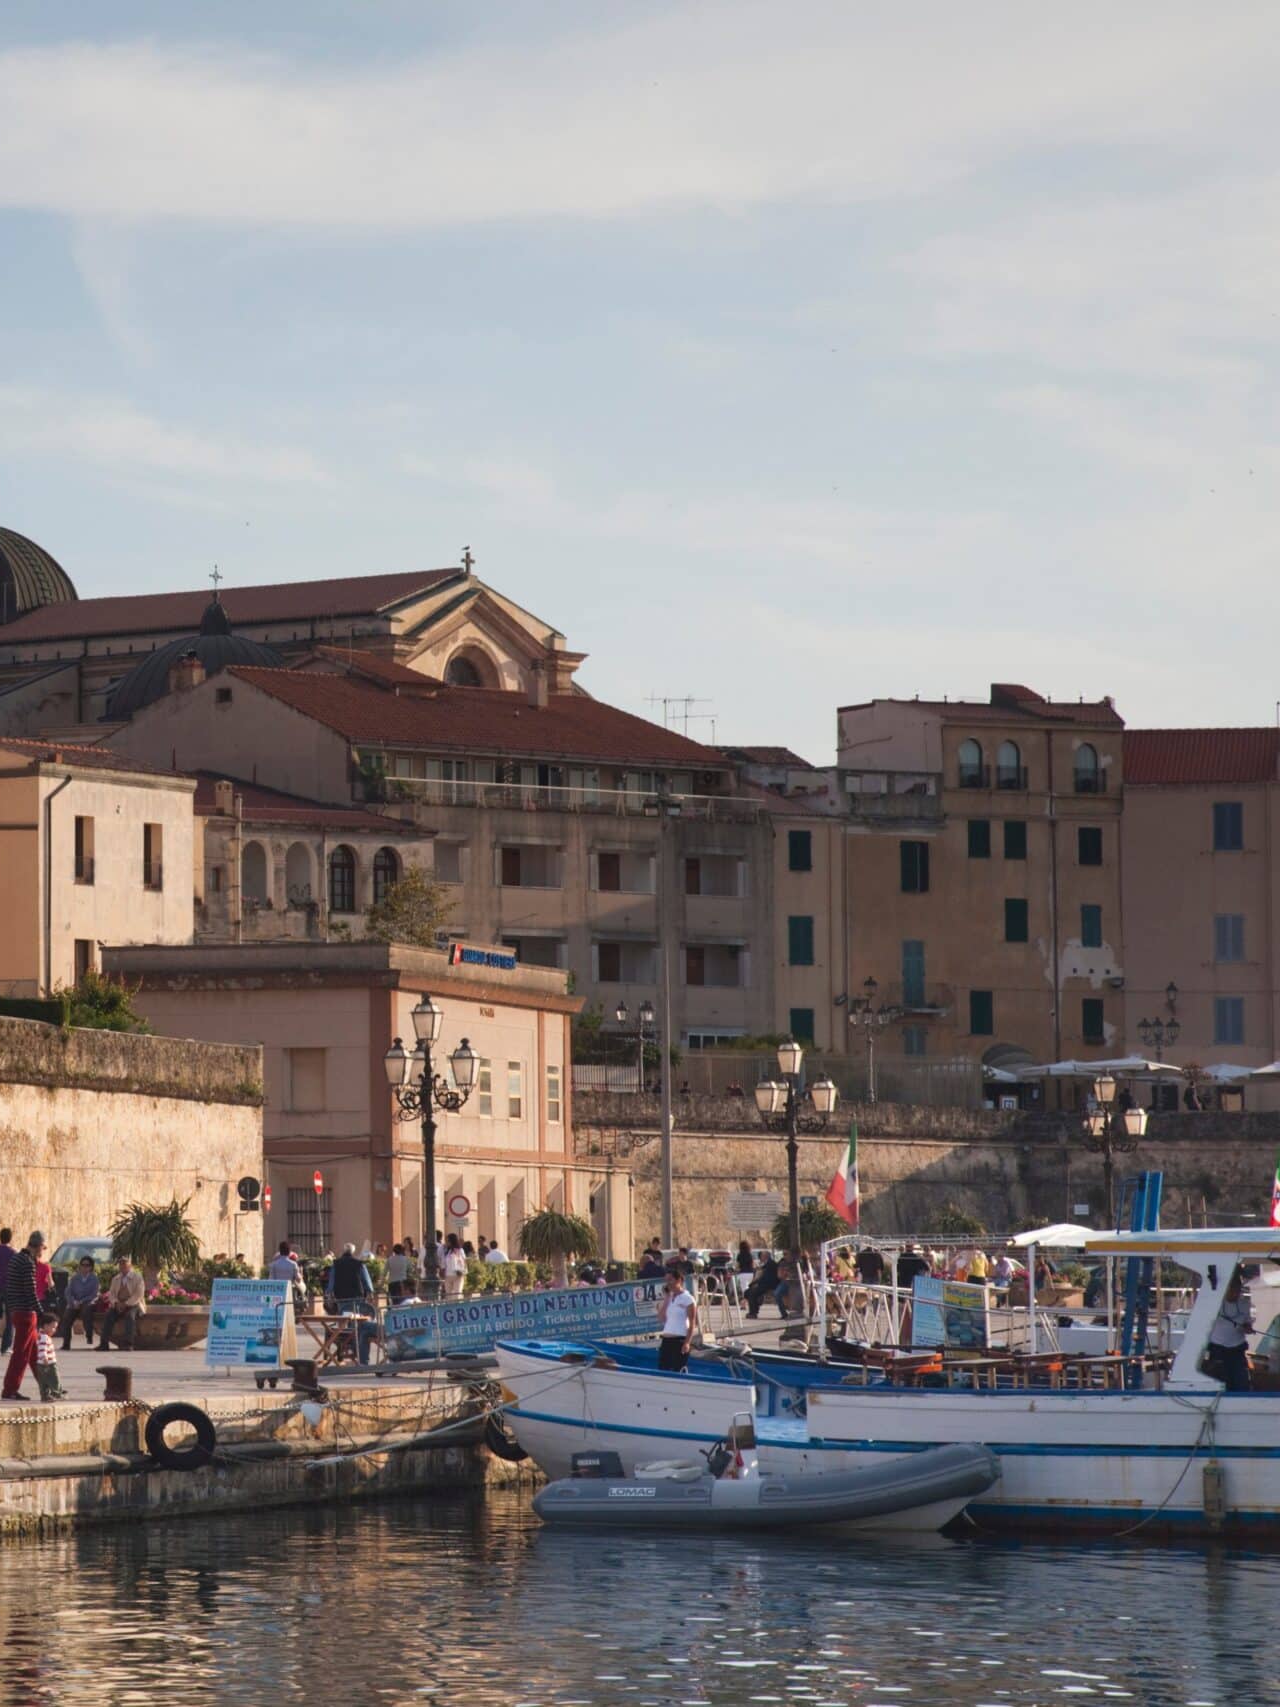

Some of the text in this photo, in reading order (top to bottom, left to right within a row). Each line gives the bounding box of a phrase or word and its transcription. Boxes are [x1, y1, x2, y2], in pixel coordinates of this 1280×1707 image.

[442, 1301, 514, 1326] GROTTE
[520, 1300, 538, 1315] DI
[544, 1288, 629, 1313] NETTUNO
[484, 1323, 493, 1333] A
[544, 1312, 580, 1326] Tickets
[583, 1310, 597, 1321] on
[599, 1306, 631, 1320] Board
[608, 1487, 656, 1497] LOMAC
